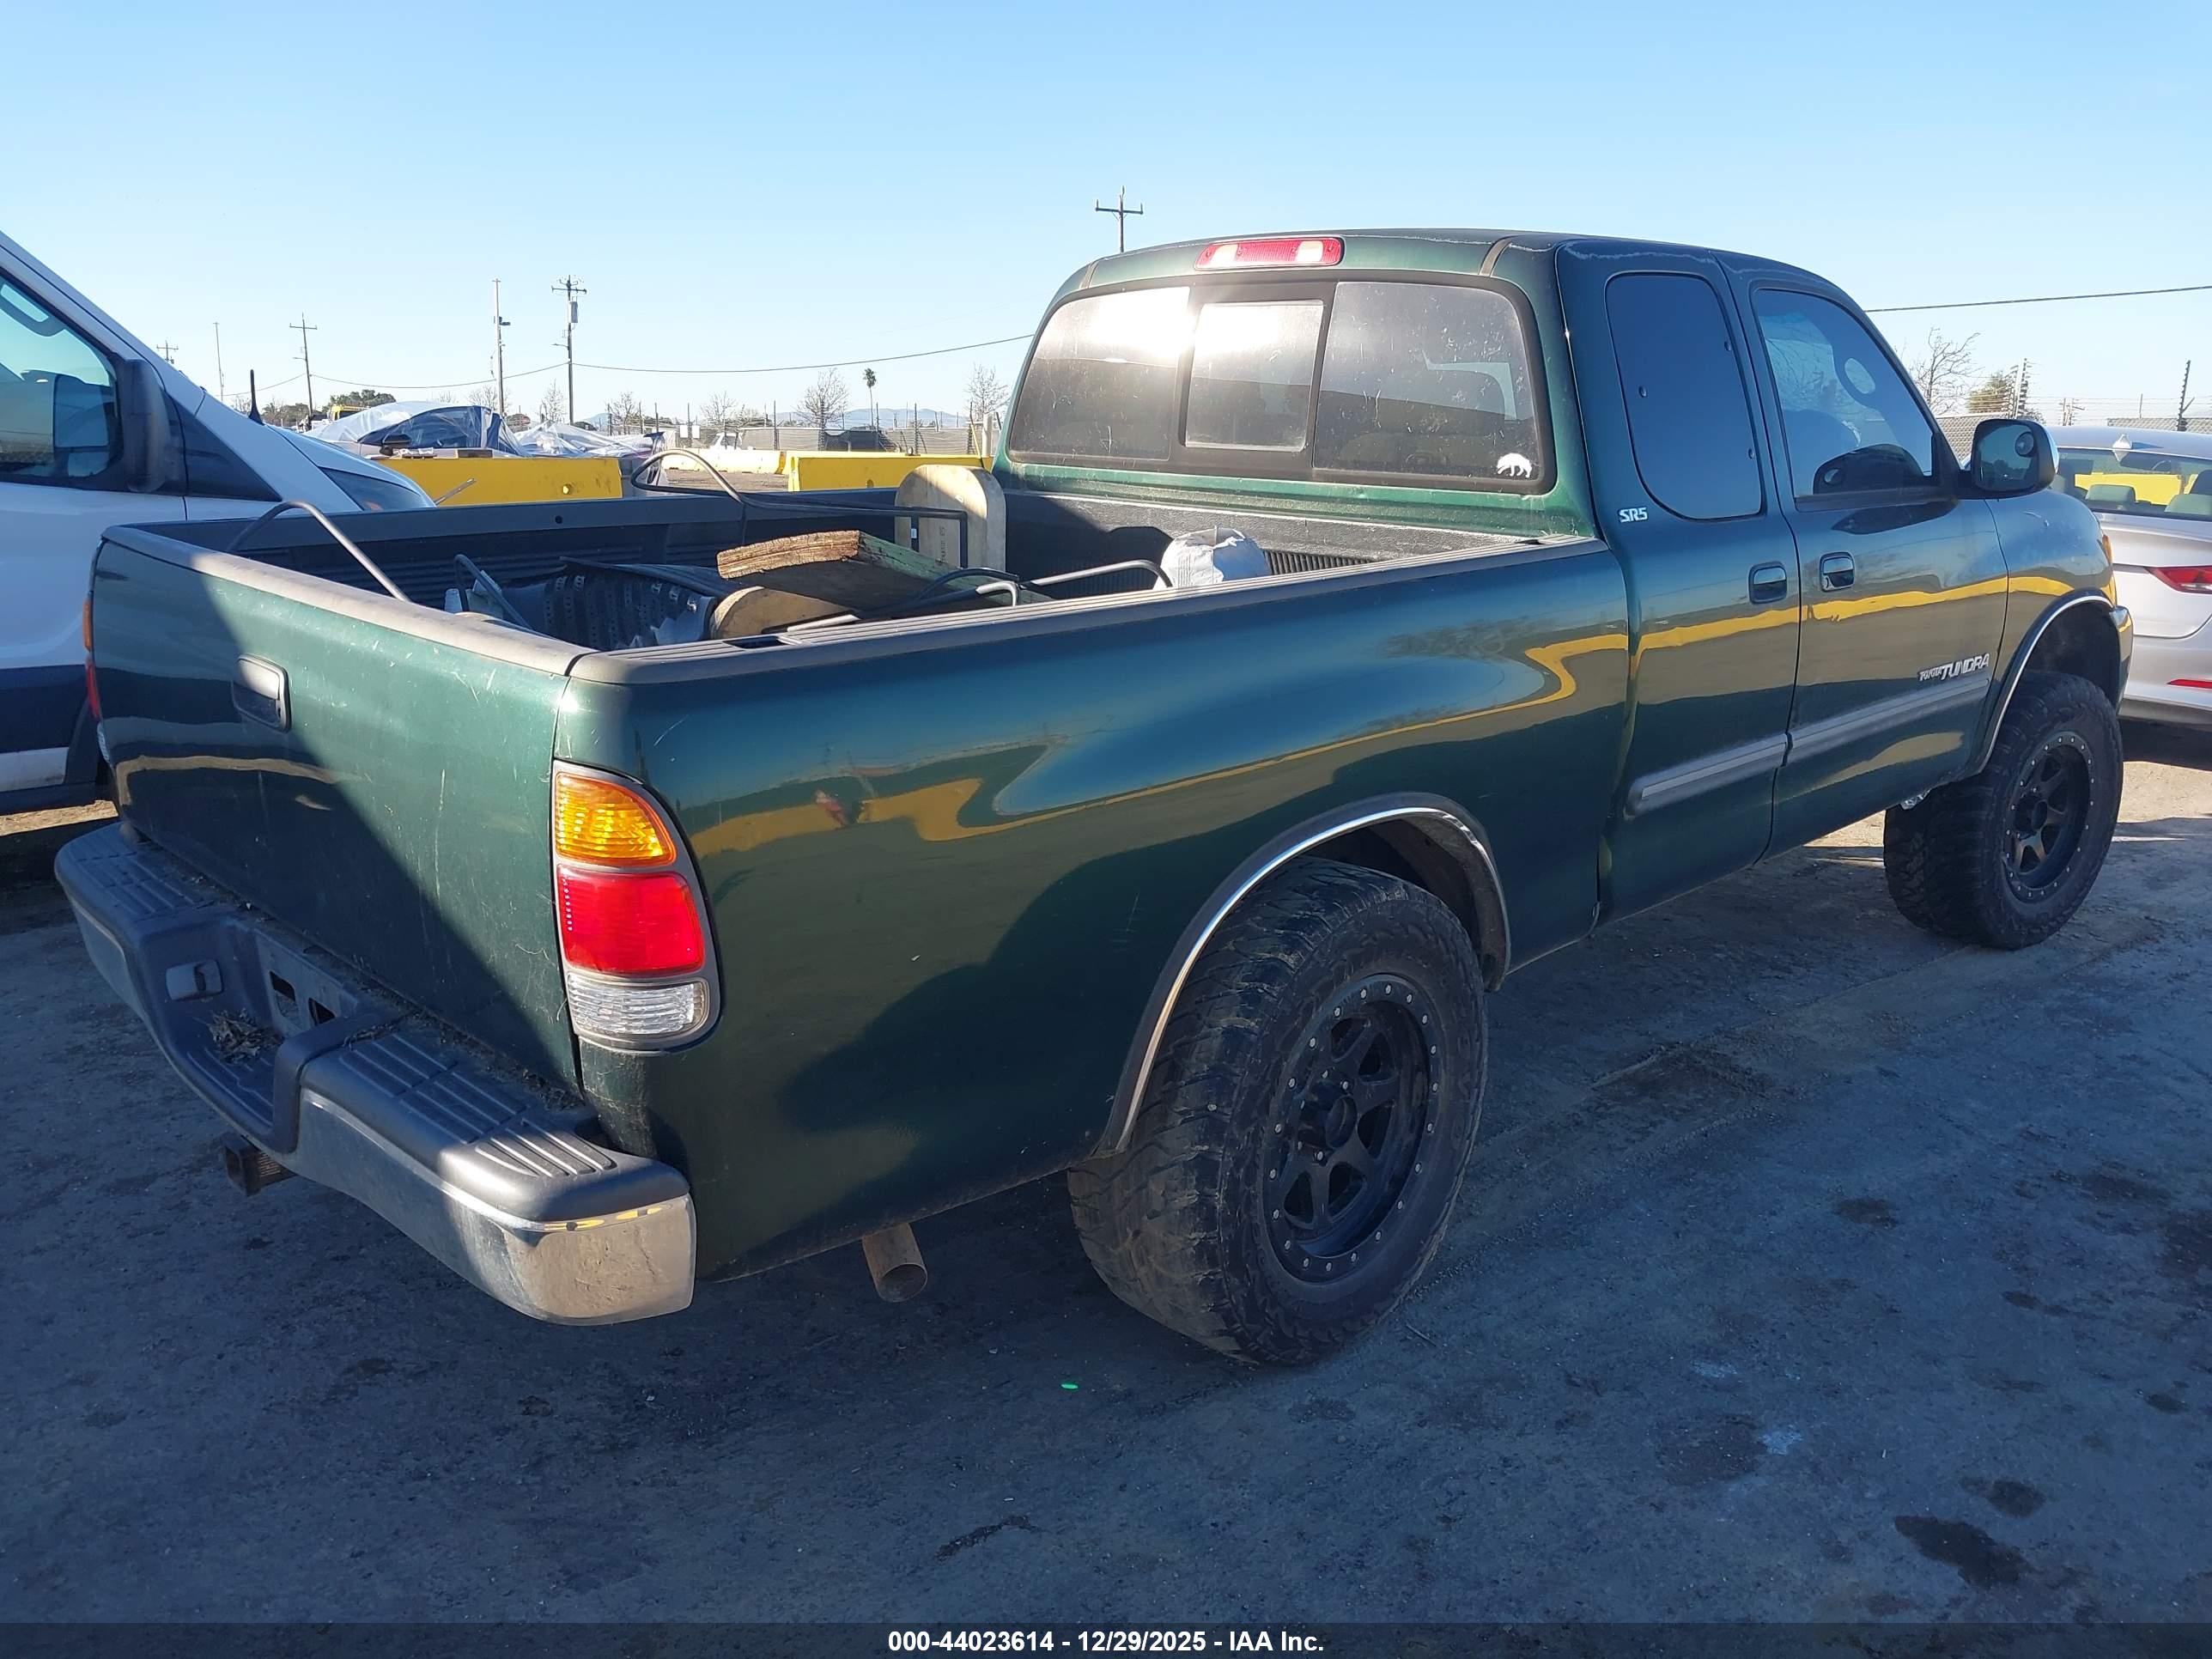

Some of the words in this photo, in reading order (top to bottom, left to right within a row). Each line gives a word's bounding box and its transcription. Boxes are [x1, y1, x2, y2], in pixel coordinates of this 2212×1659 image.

[1619, 507, 1648, 523] SR5
[1918, 667, 1942, 682] TOYOTA
[1940, 653, 1990, 681] TUNDRA
